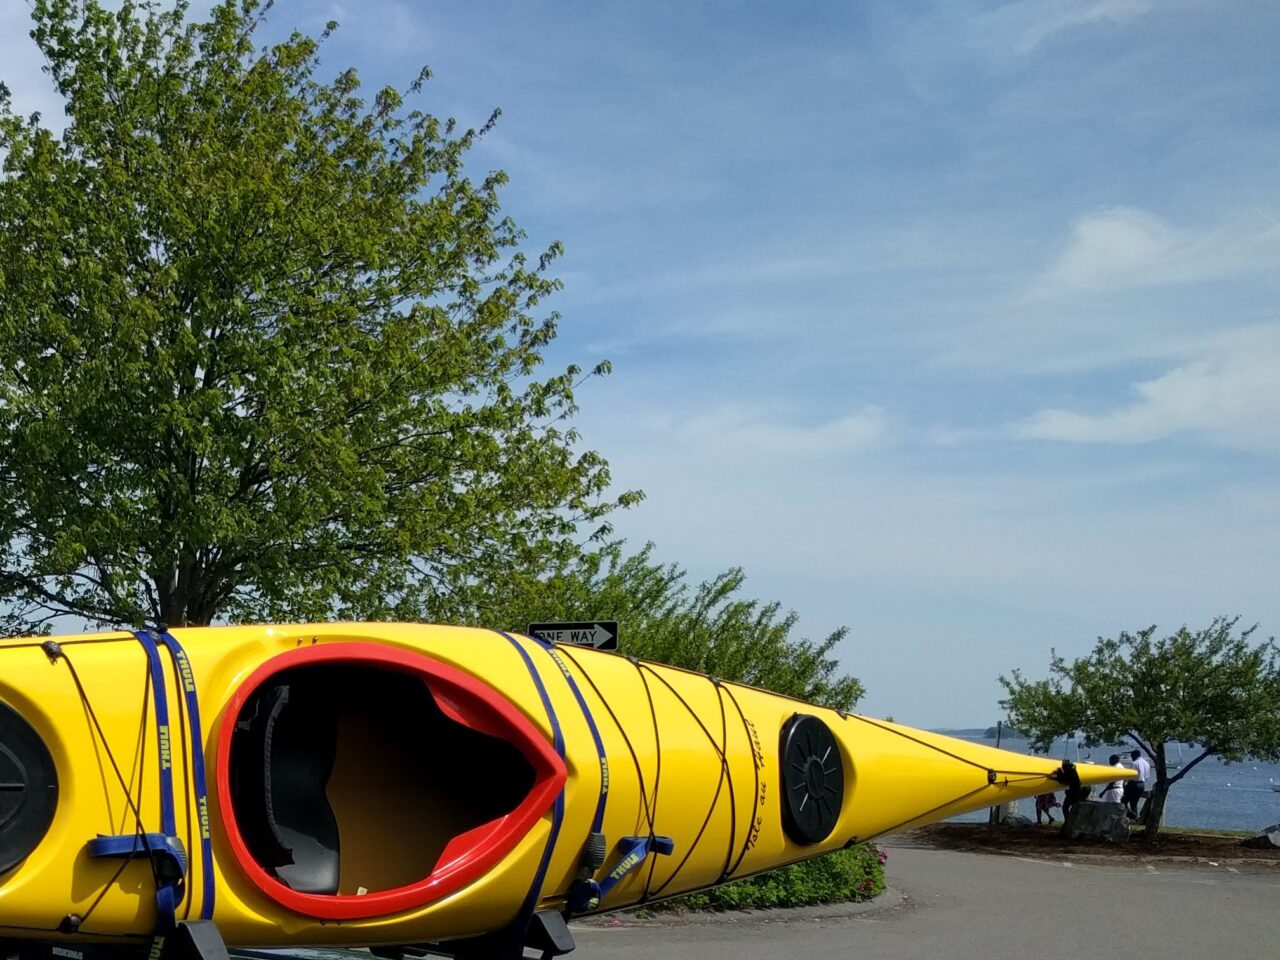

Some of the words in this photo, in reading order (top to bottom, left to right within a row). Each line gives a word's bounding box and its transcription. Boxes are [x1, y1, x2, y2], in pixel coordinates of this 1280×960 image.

[570, 630, 597, 642] WAY
[176, 650, 195, 692] THULE
[159, 725, 171, 770] THULE
[600, 757, 609, 795] THULE
[760, 783, 767, 806] au
[199, 795, 210, 839] THULE
[610, 852, 639, 879] THULE
